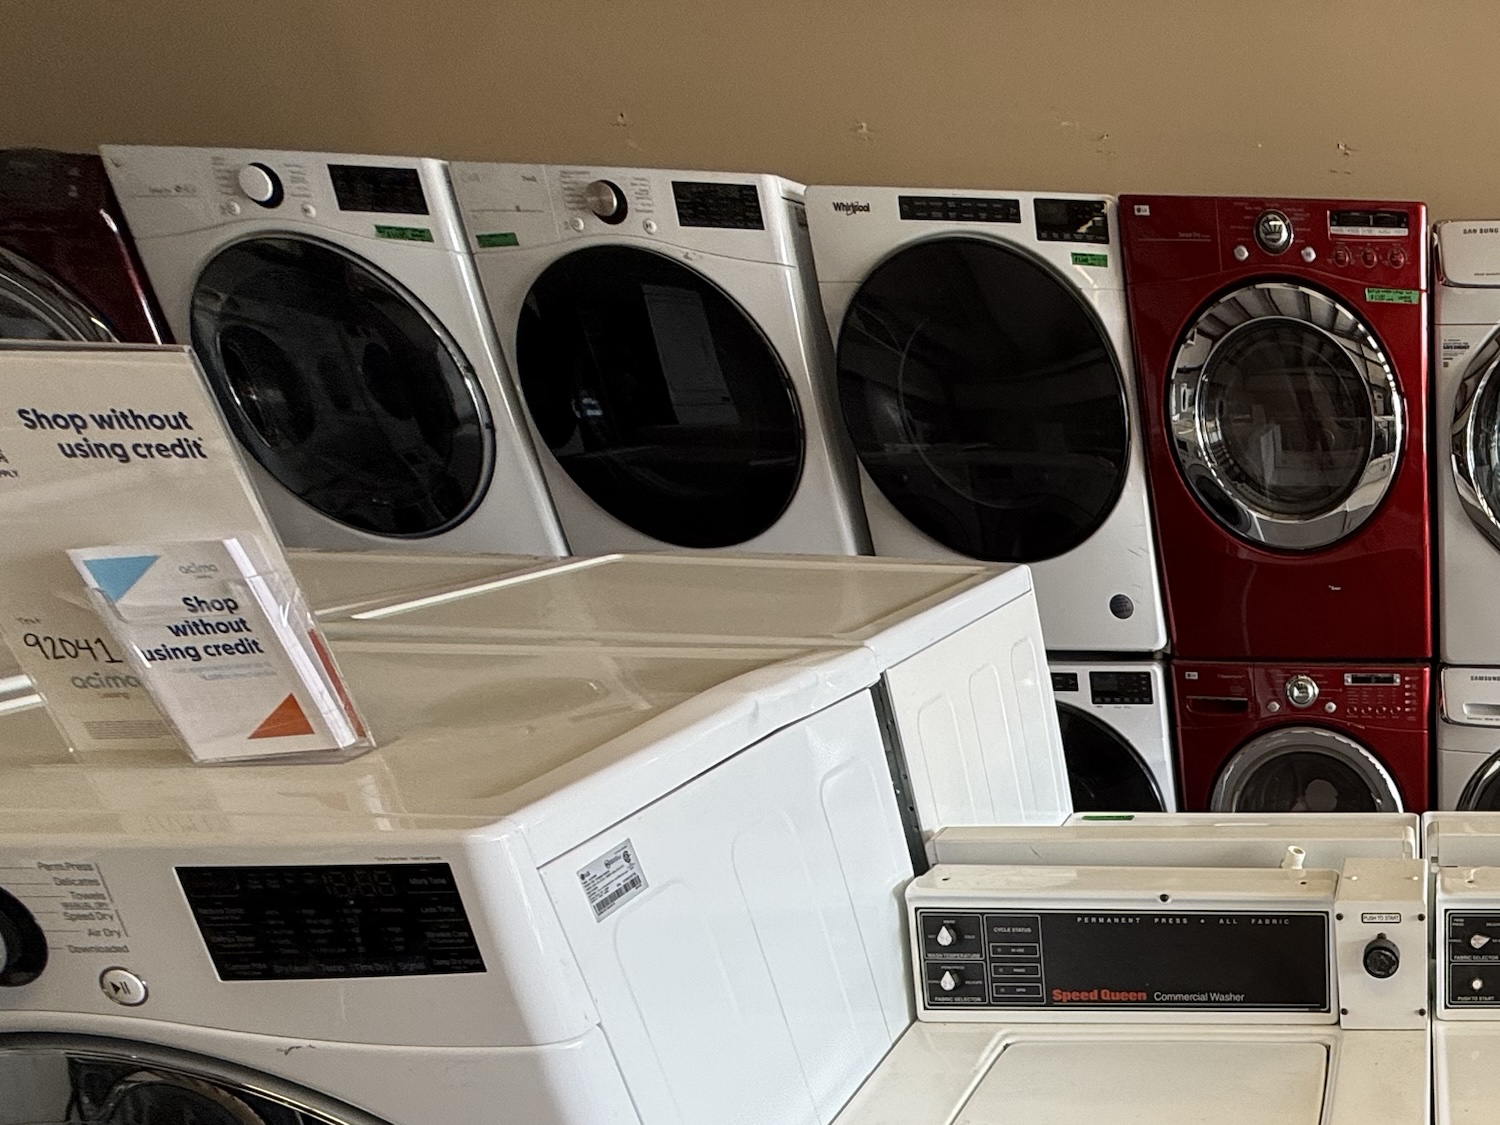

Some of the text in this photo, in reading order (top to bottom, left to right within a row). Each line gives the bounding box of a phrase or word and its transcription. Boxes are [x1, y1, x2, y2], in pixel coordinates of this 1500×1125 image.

[833, 201, 870, 216] Whirlpool
[17, 408, 193, 435] Shop without
[58, 437, 207, 463] using credit
[178, 562, 219, 574] acima
[182, 596, 239, 616] Shop
[167, 617, 252, 638] without
[144, 638, 264, 662] using credit
[71, 673, 142, 690] acima
[103, 928, 121, 938] Dry
[1052, 988, 1246, 1002] Speed Queen Commercial Washer
